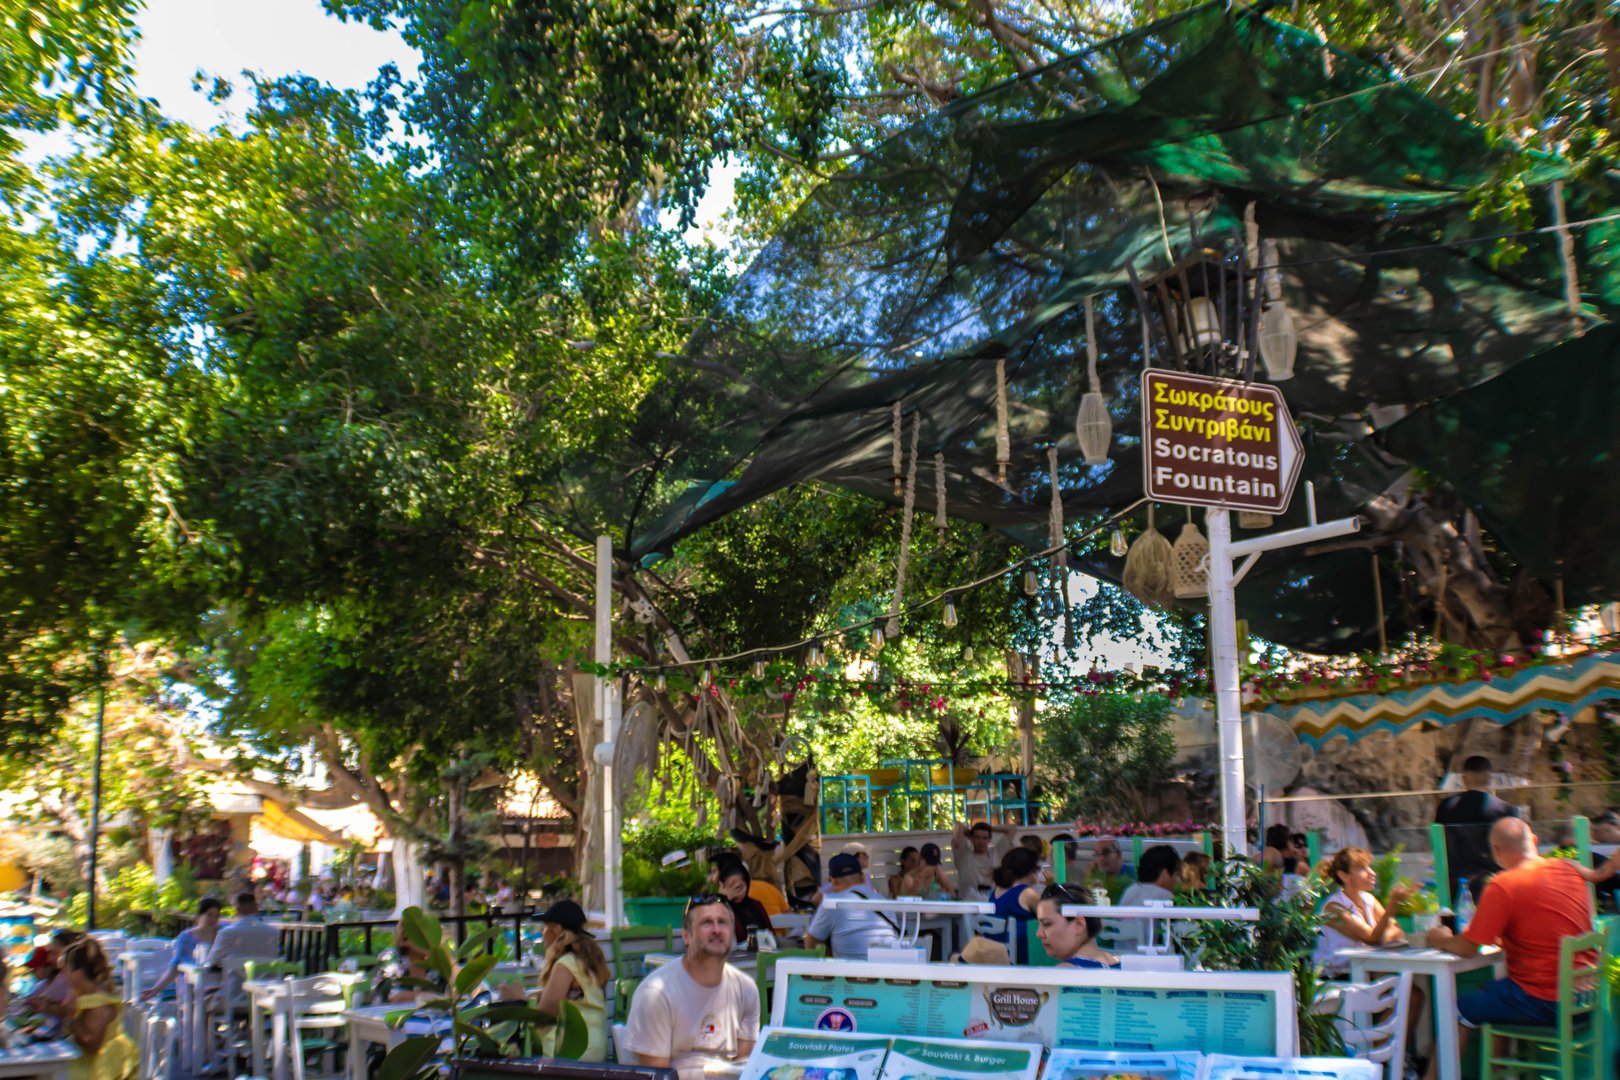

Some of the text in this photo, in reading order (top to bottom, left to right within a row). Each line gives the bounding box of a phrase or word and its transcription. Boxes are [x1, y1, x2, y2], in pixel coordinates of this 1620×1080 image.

[1153, 381, 1275, 423] Σωκράτους
[1154, 408, 1271, 443] Συντριβάνι
[1154, 437, 1278, 470] Socratous
[1155, 466, 1276, 498] Fountain
[993, 994, 1039, 1005] Grill House
[788, 1041, 855, 1053] Souvlaki Plates
[921, 1048, 1007, 1066] Souvlaki & Burger
